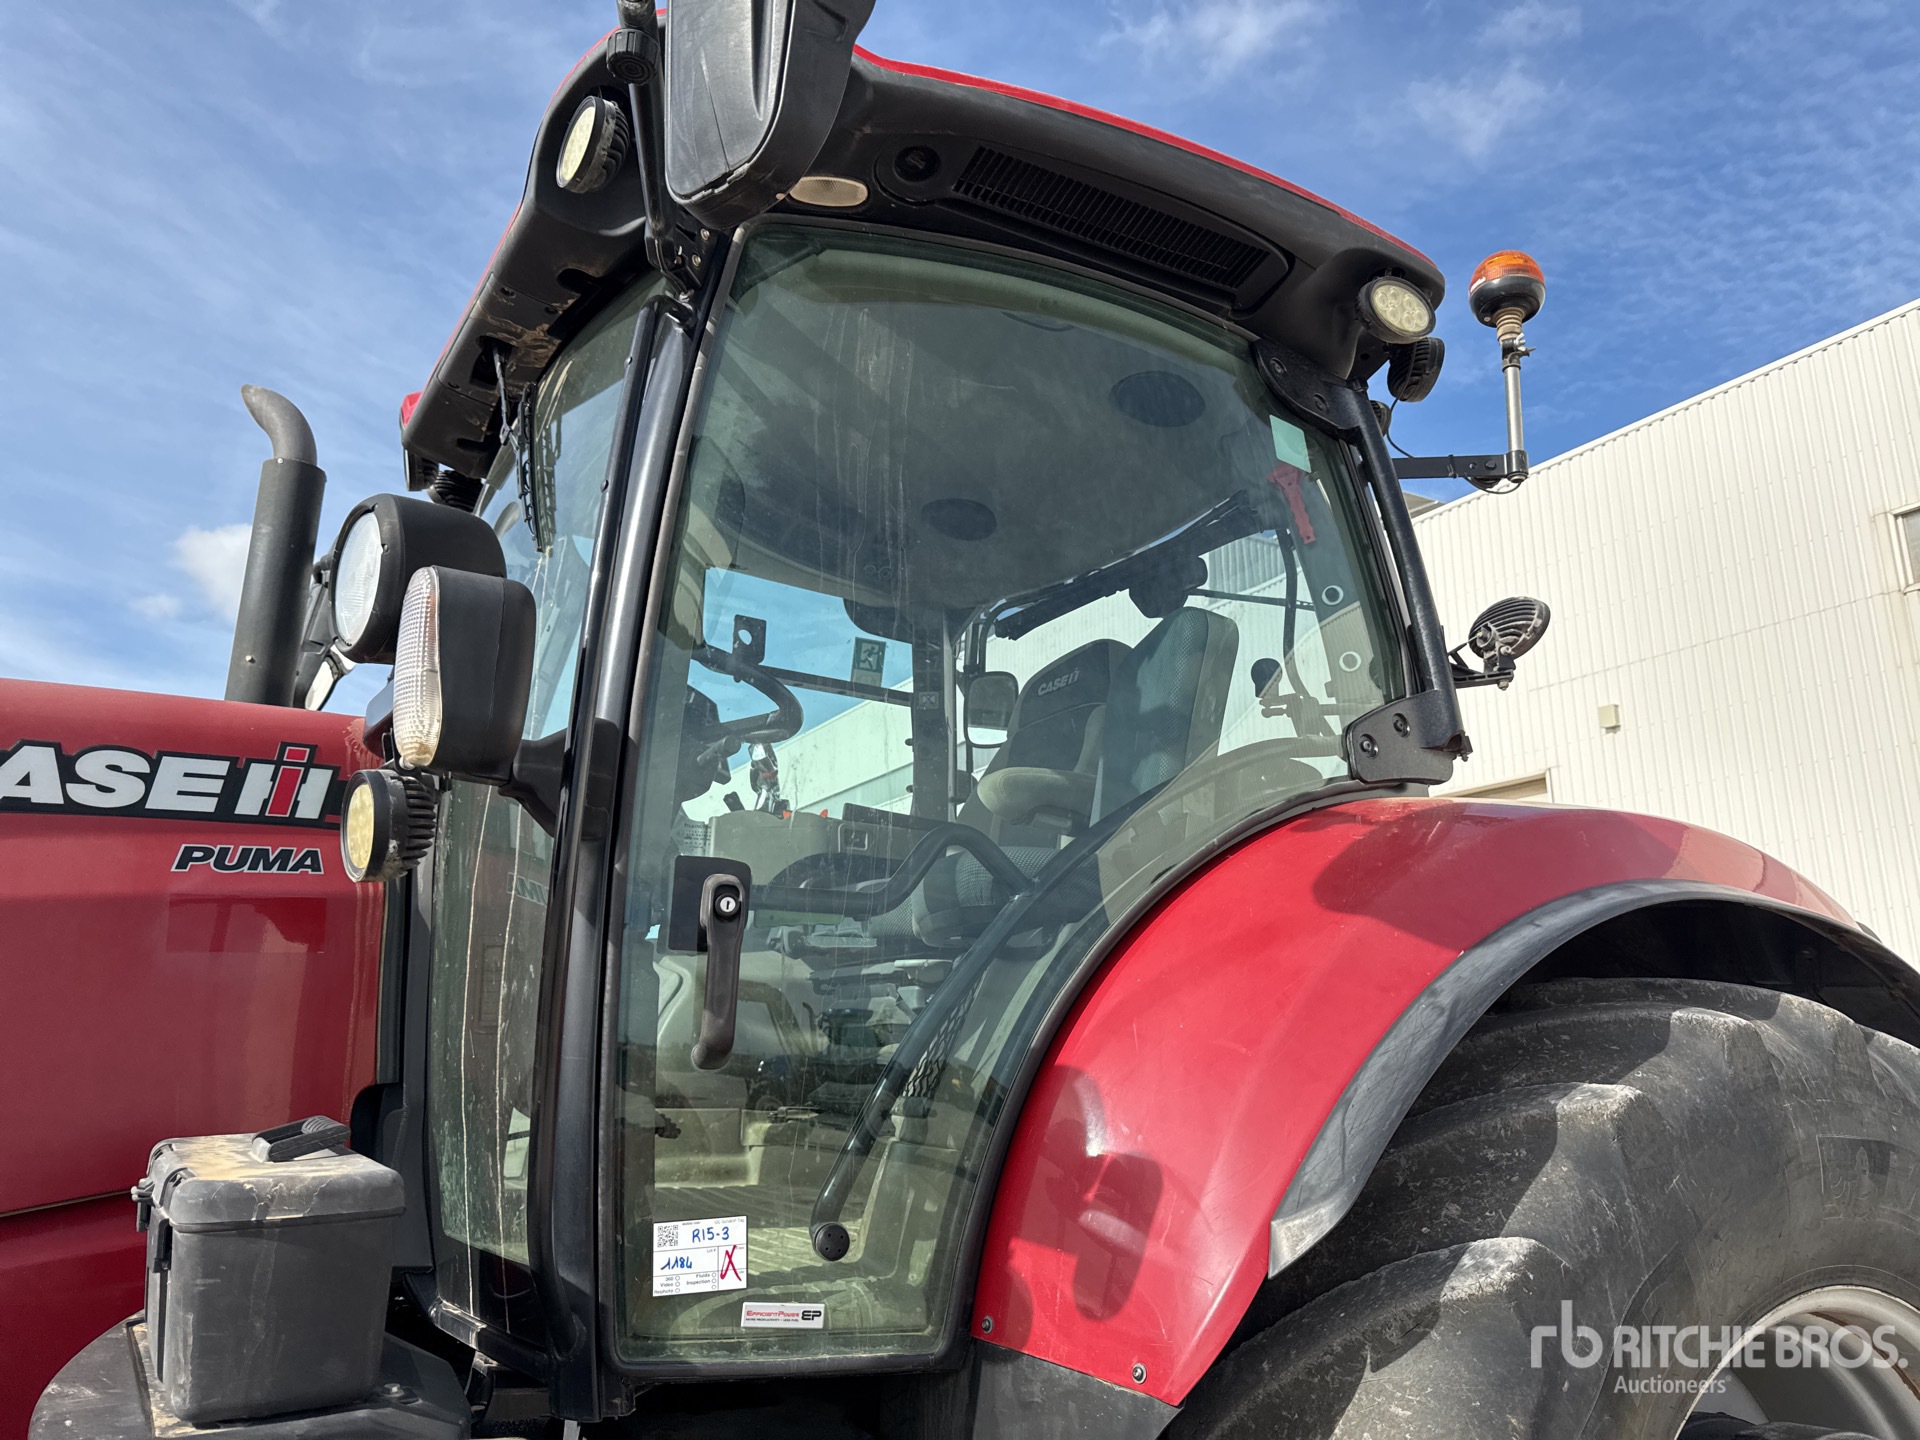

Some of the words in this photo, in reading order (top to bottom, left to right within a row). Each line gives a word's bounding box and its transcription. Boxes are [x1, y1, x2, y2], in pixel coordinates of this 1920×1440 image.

[1038, 674, 1070, 696] CASE
[171, 844, 324, 874] PUMA
[692, 1226, 730, 1243] R15-3
